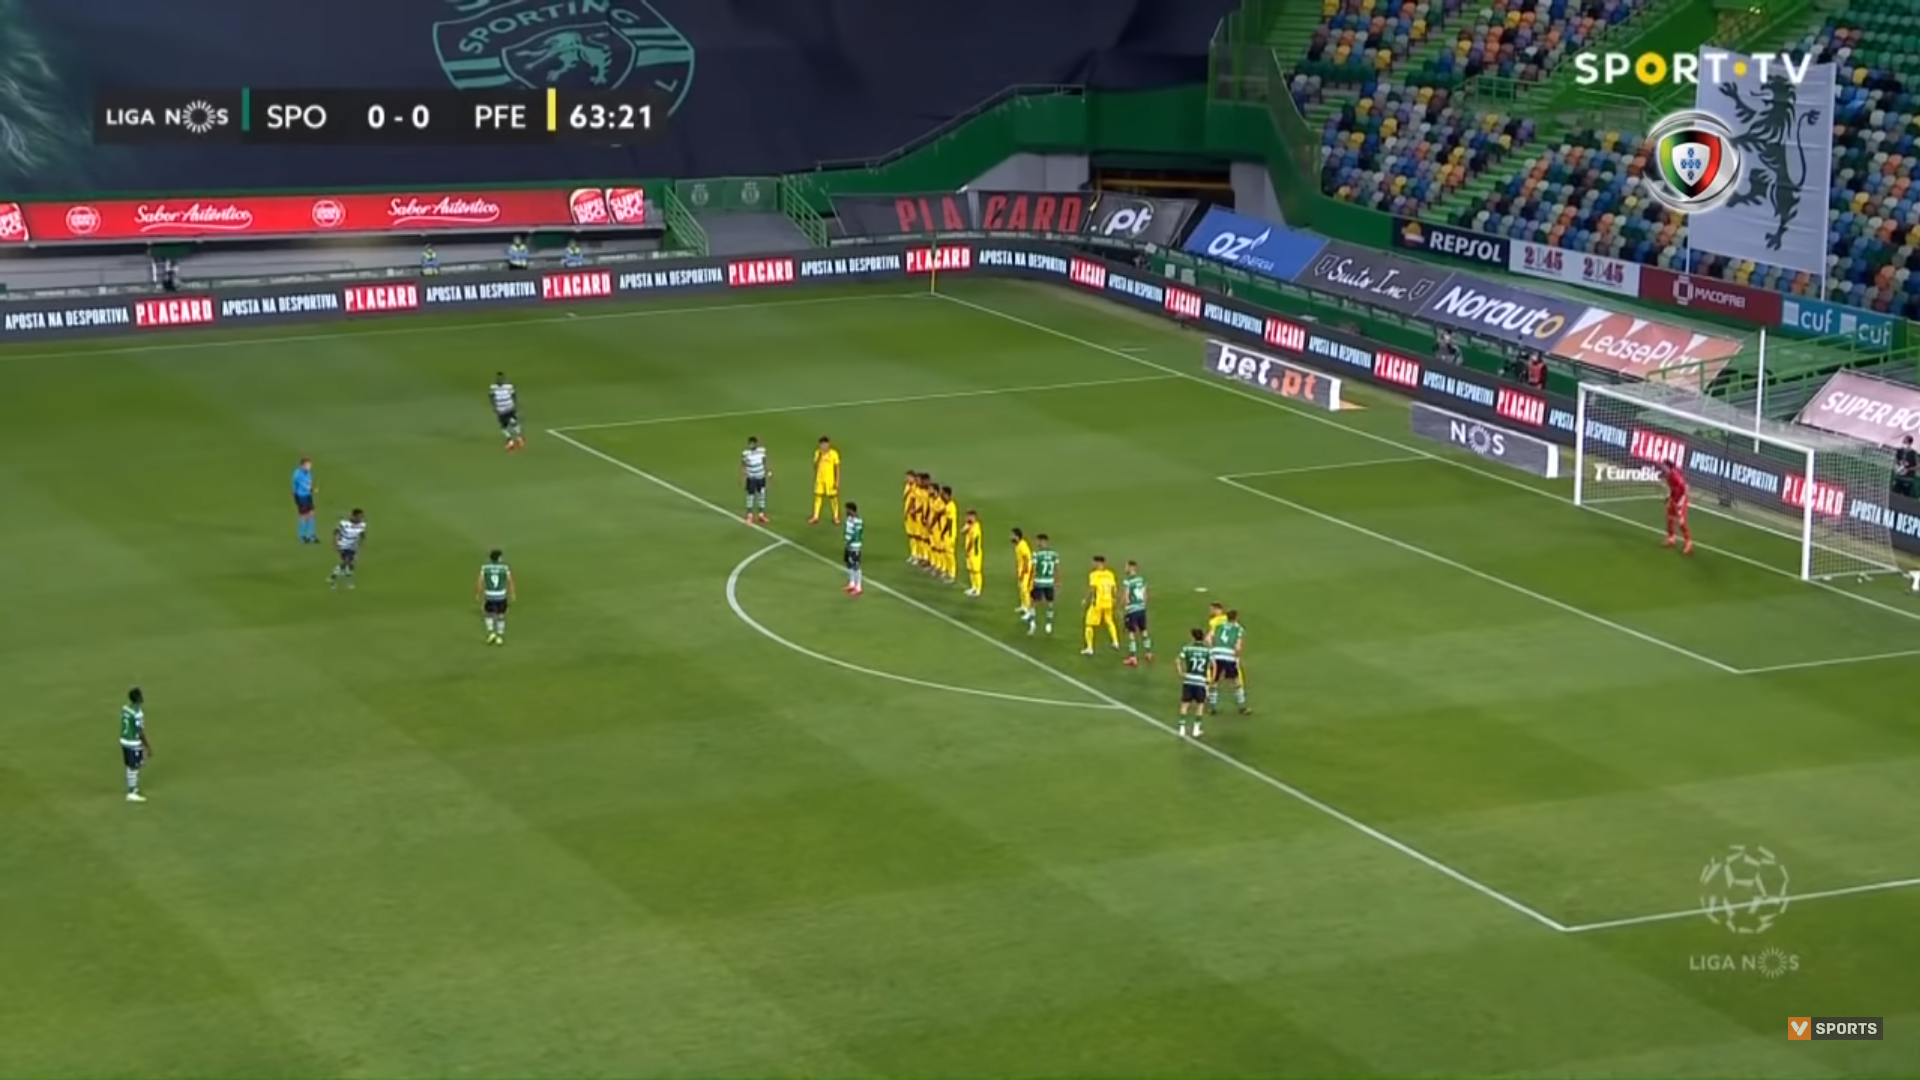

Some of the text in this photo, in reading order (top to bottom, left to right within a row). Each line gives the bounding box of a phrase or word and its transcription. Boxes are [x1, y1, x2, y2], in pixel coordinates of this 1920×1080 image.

[459, 0, 640, 54] SPORTING
[801, 248, 971, 276] APOSTA NA DESPORTIVA PLACARD
[1208, 232, 1253, 260] OZ
[1429, 231, 1502, 263] REPSOL
[619, 259, 794, 290] APOSTA NA DESPORTIVA PLACARD
[979, 249, 1013, 266] APOSTA
[1014, 251, 1026, 268] NA
[1069, 257, 1106, 290] PLACARD
[1328, 258, 1407, 299] Suits Inc
[222, 285, 419, 317] APOSTA NA DESPORTIVA PLACARD
[425, 272, 611, 303] APOSTA NA DESPORTIVA PLACARD
[1165, 286, 1202, 319] PLACARD
[5, 298, 214, 331] APOSTA NA DESPORTIVA PLACARD
[1433, 284, 1566, 340] Norauto
[1801, 309, 1833, 334] cuf
[1264, 317, 1306, 351] PLACARD
[1580, 323, 1702, 375] LeasePlan
[1858, 320, 1891, 346] cuf
[1217, 344, 1317, 401] bet.pt
[1373, 352, 1420, 387] PLACARD
[1496, 387, 1546, 427] PLACARD
[1821, 391, 1893, 425] SUPER
[1450, 420, 1506, 457] NOS
[1630, 431, 1686, 469] PLACARD
[1606, 464, 1662, 482] EuroBic
[1690, 450, 1719, 476] APOSTA
[1731, 462, 1779, 494] DESPORTIVA
[489, 573, 500, 589] 9
